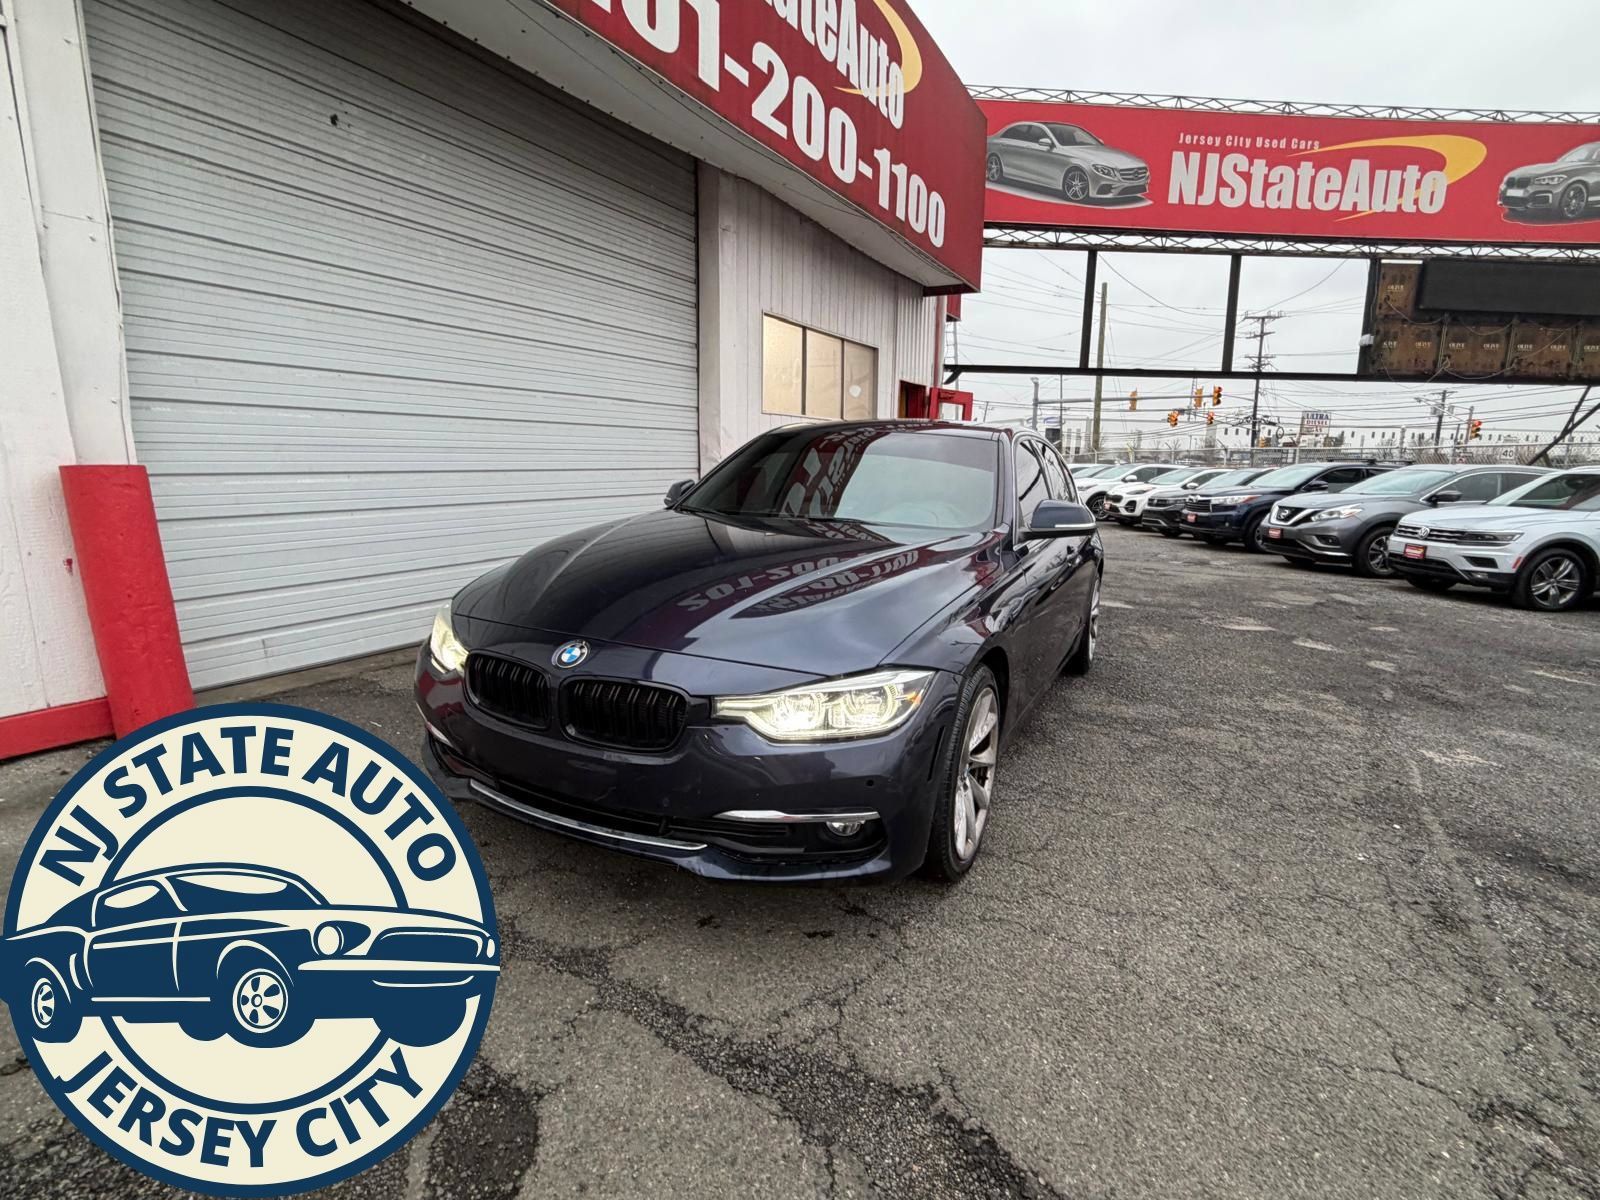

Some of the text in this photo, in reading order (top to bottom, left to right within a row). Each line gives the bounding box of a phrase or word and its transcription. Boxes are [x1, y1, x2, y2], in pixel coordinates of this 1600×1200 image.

[591, 0, 945, 248] 1-200-1100
[1179, 132, 1320, 150] Jersey City Used Cars
[1168, 151, 1448, 214] NJStateAuto
[1502, 449, 1514, 458] 40
